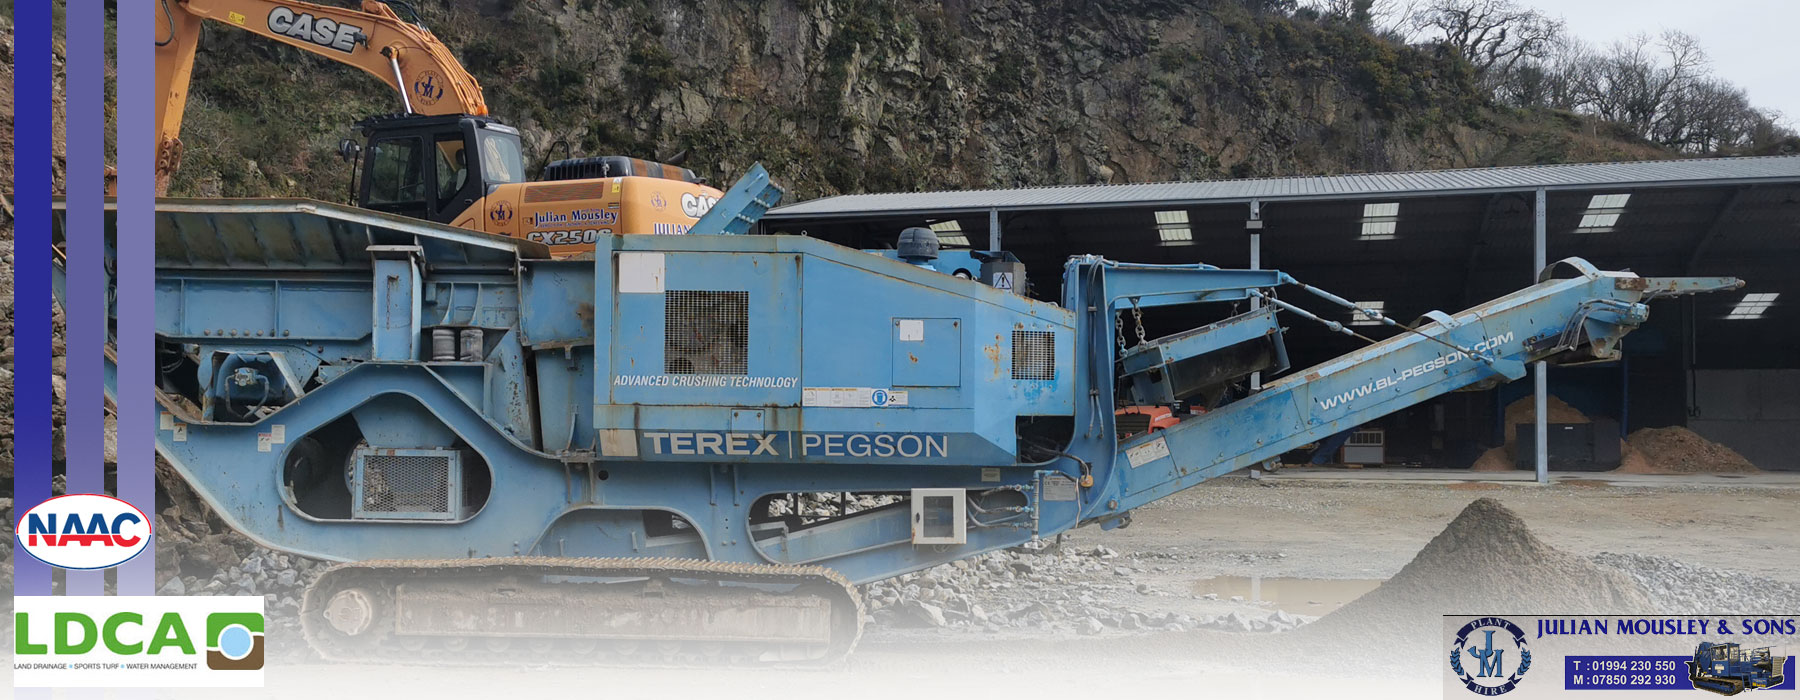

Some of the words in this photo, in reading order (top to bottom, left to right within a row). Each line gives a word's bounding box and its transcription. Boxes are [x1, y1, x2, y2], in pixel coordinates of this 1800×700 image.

[268, 6, 361, 53] CASE
[535, 211, 567, 227] Julian
[572, 209, 618, 225] Mousley
[614, 375, 669, 386] ADVANCED
[672, 375, 727, 387] CRUSHING
[730, 376, 798, 388] TECHNOLOGY
[644, 432, 779, 456] TEREX
[802, 434, 948, 458] PEGSON
